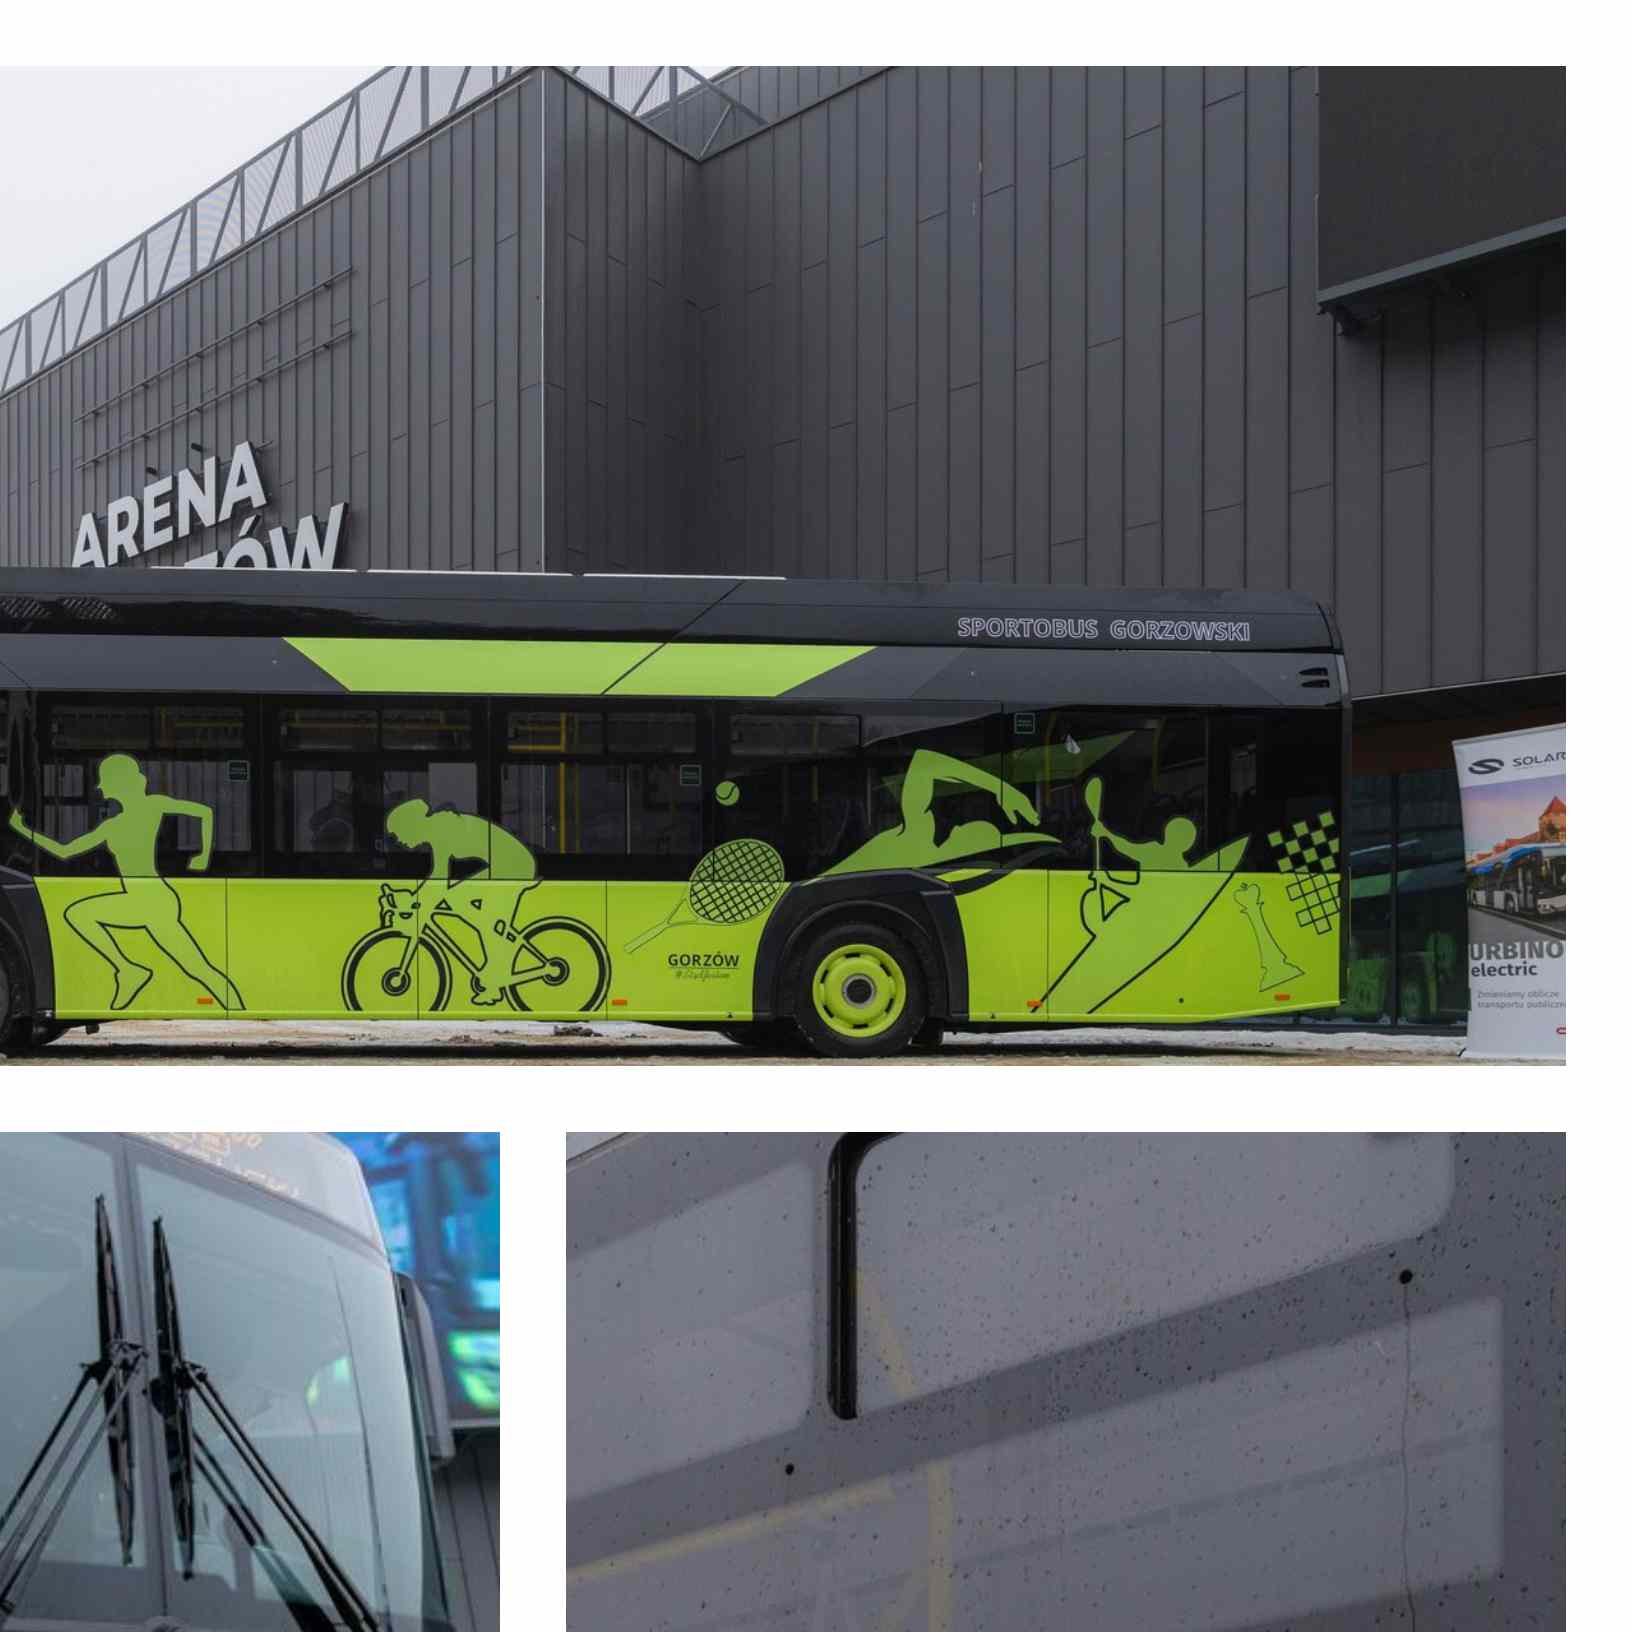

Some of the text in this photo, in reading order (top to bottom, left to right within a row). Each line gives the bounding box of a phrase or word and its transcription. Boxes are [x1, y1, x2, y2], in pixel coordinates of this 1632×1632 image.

[72, 441, 266, 568] ARENA
[957, 617, 1251, 642] SPORTOBUS GORZOWSKI
[668, 951, 740, 967] GORZÓW
[1470, 941, 1564, 960] URBINO
[1471, 961, 1539, 977] electric
